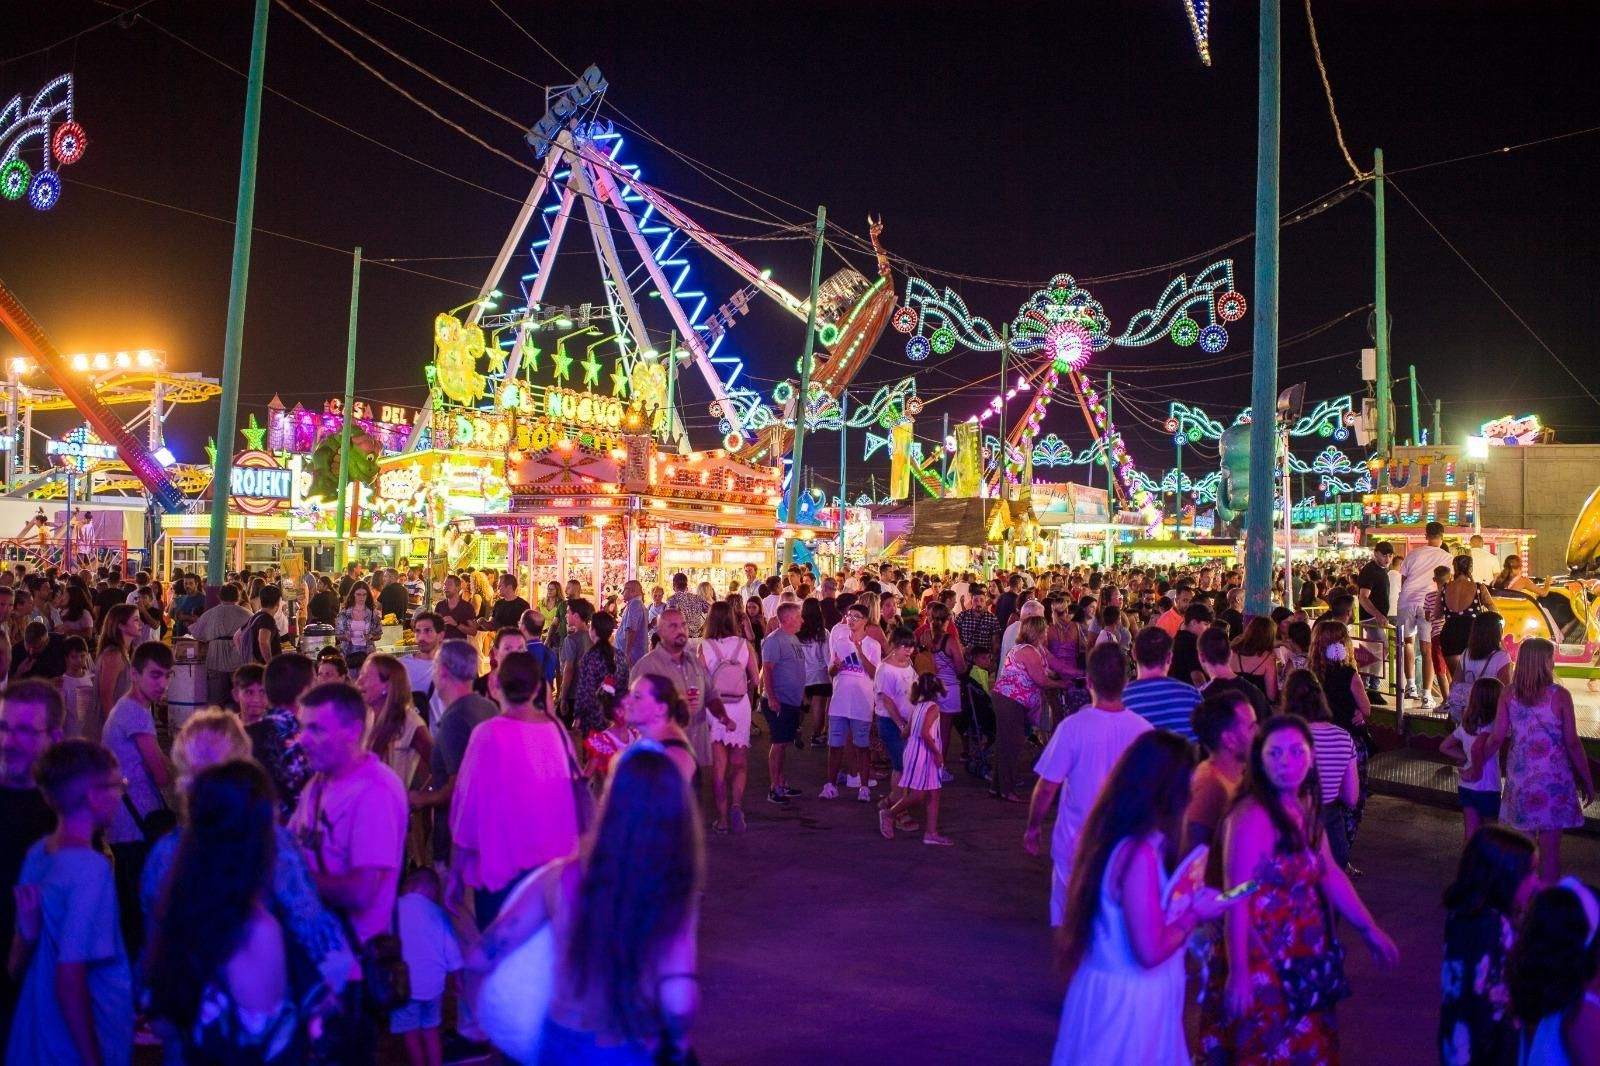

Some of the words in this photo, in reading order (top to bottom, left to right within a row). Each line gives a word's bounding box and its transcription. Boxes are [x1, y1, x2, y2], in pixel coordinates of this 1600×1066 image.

[330, 398, 374, 420] CSA
[382, 405, 407, 425] DEL
[549, 391, 622, 427] NUEVO
[231, 467, 291, 497] ROJEKT
[1362, 491, 1475, 525] FRUTTI
